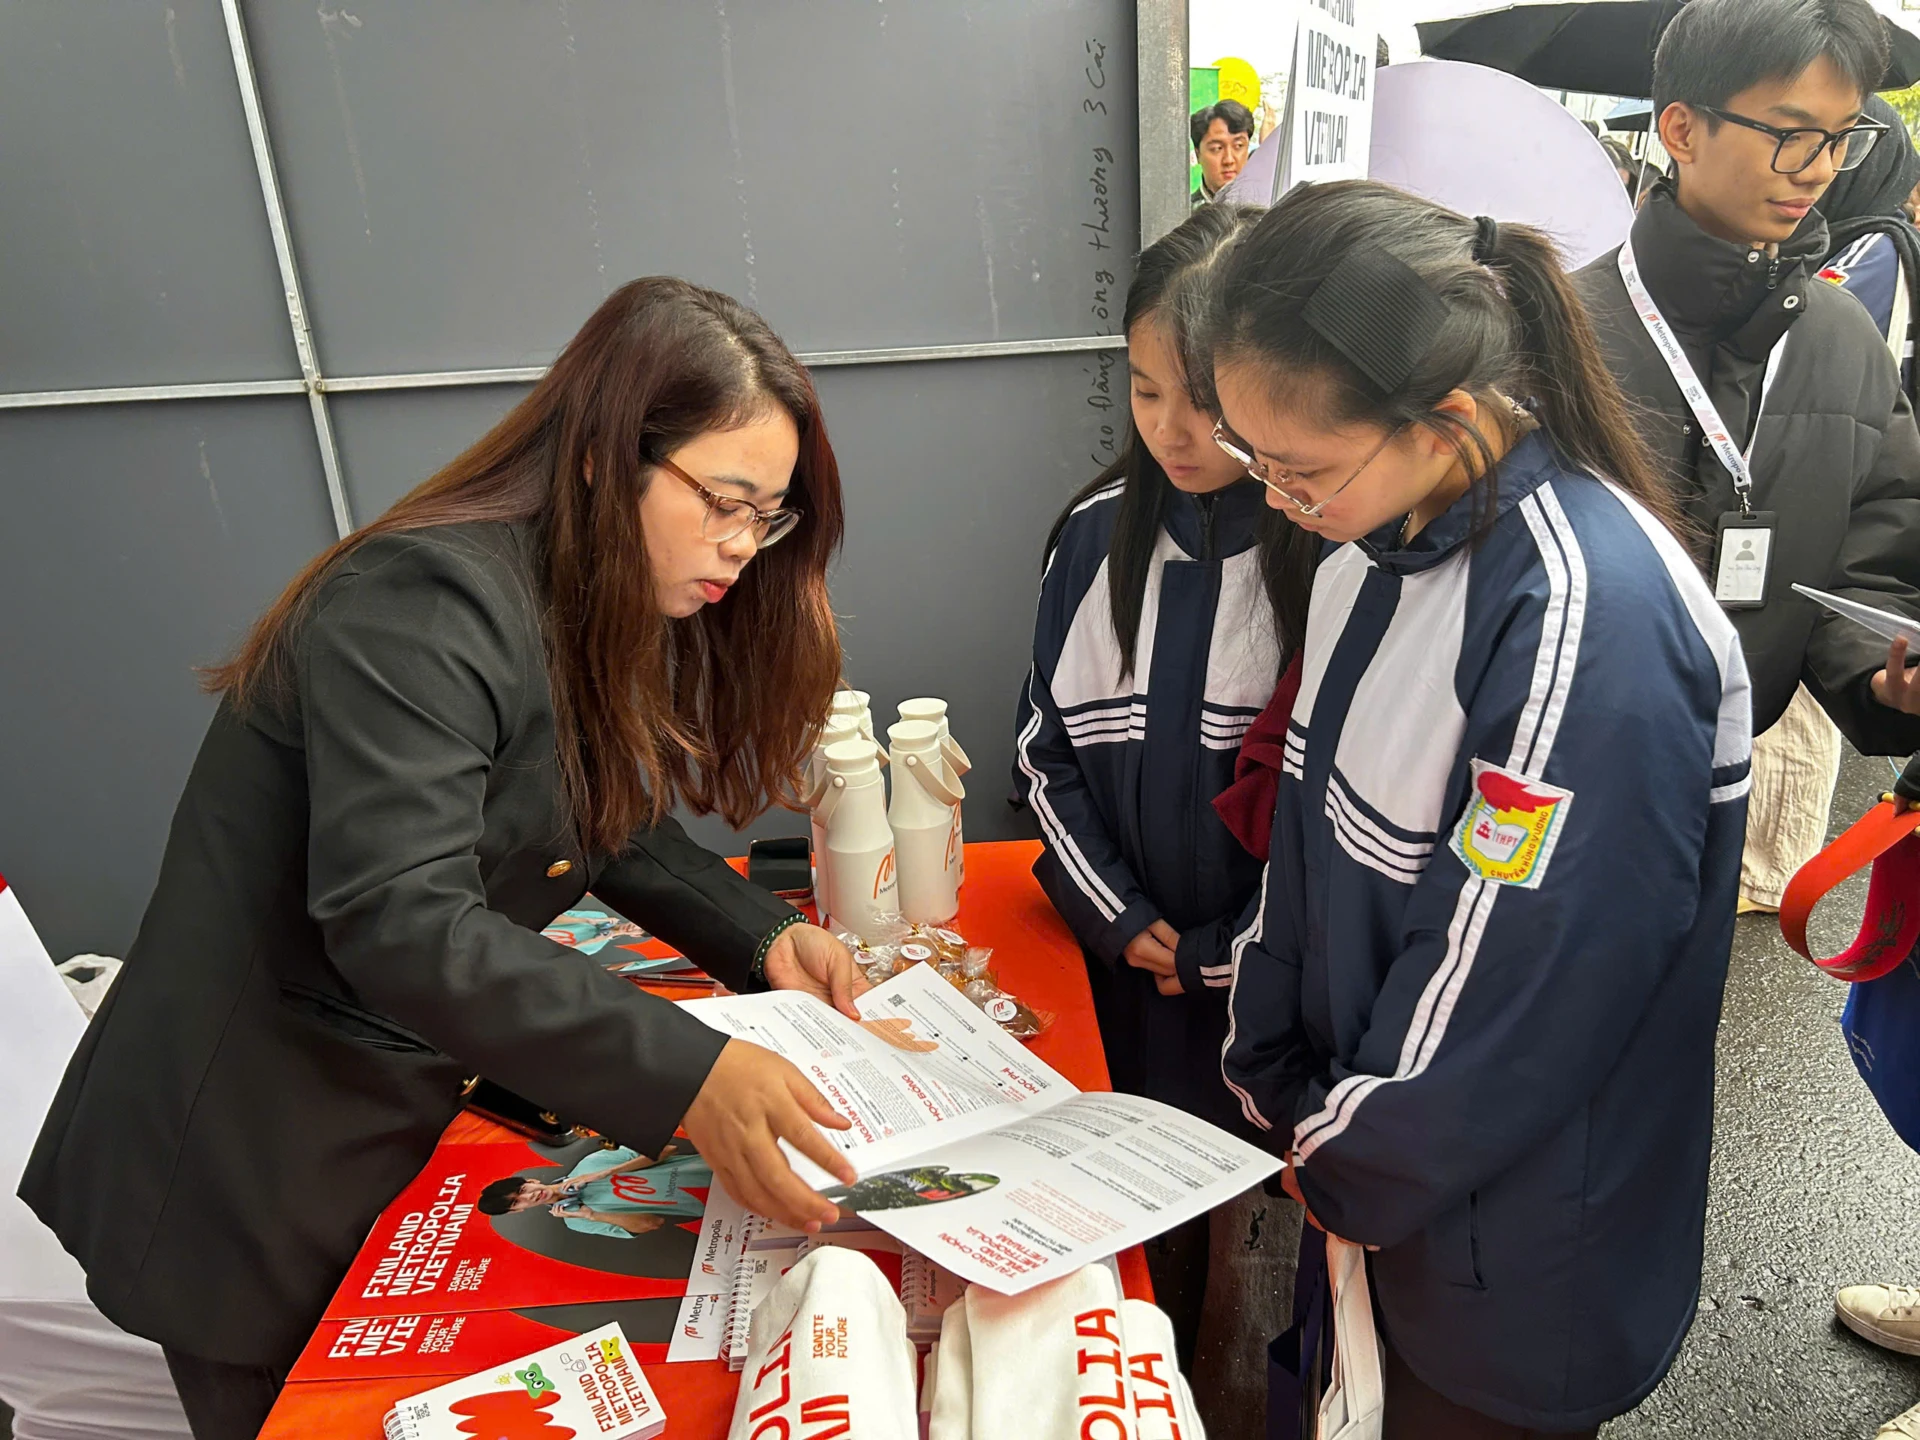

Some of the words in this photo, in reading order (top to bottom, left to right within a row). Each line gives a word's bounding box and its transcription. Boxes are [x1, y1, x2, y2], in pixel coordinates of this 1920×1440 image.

[1083, 98, 1107, 116] 3
[1652, 321, 1678, 360] Metropolia
[1495, 833, 1518, 848] THPT
[1490, 868, 1528, 880] CHUYÊN
[810, 1065, 828, 1085] TẠO
[1018, 1078, 1040, 1094] HỌC
[828, 1084, 849, 1106] ĐÀO
[923, 1101, 944, 1122] HỌC
[845, 1104, 875, 1144] NGÀNH
[386, 1173, 467, 1297] METROPOLIA
[411, 1203, 475, 1295] VIETNAM
[704, 1219, 723, 1262] Metropolia
[966, 1226, 1040, 1269] METROPOLIA
[996, 1233, 1048, 1264] VIETNAM
[361, 1212, 424, 1298] FINLAND
[972, 1253, 997, 1268] SAO
[979, 1246, 1030, 1274] FINLAND
[447, 1258, 470, 1292] IGNITE
[458, 1267, 476, 1292] YOUR
[469, 1257, 491, 1291] FUTURE
[417, 1318, 444, 1354] IGNITE
[429, 1327, 450, 1353] YOUR
[440, 1316, 466, 1353] FUTURE
[813, 1314, 824, 1358] IGNITE
[825, 1327, 835, 1358] YOUR
[837, 1316, 848, 1358] FUTURE
[584, 1341, 634, 1426] METROPOLIA
[610, 1355, 650, 1418] VIETNAM
[578, 1373, 616, 1433] FINLAND
